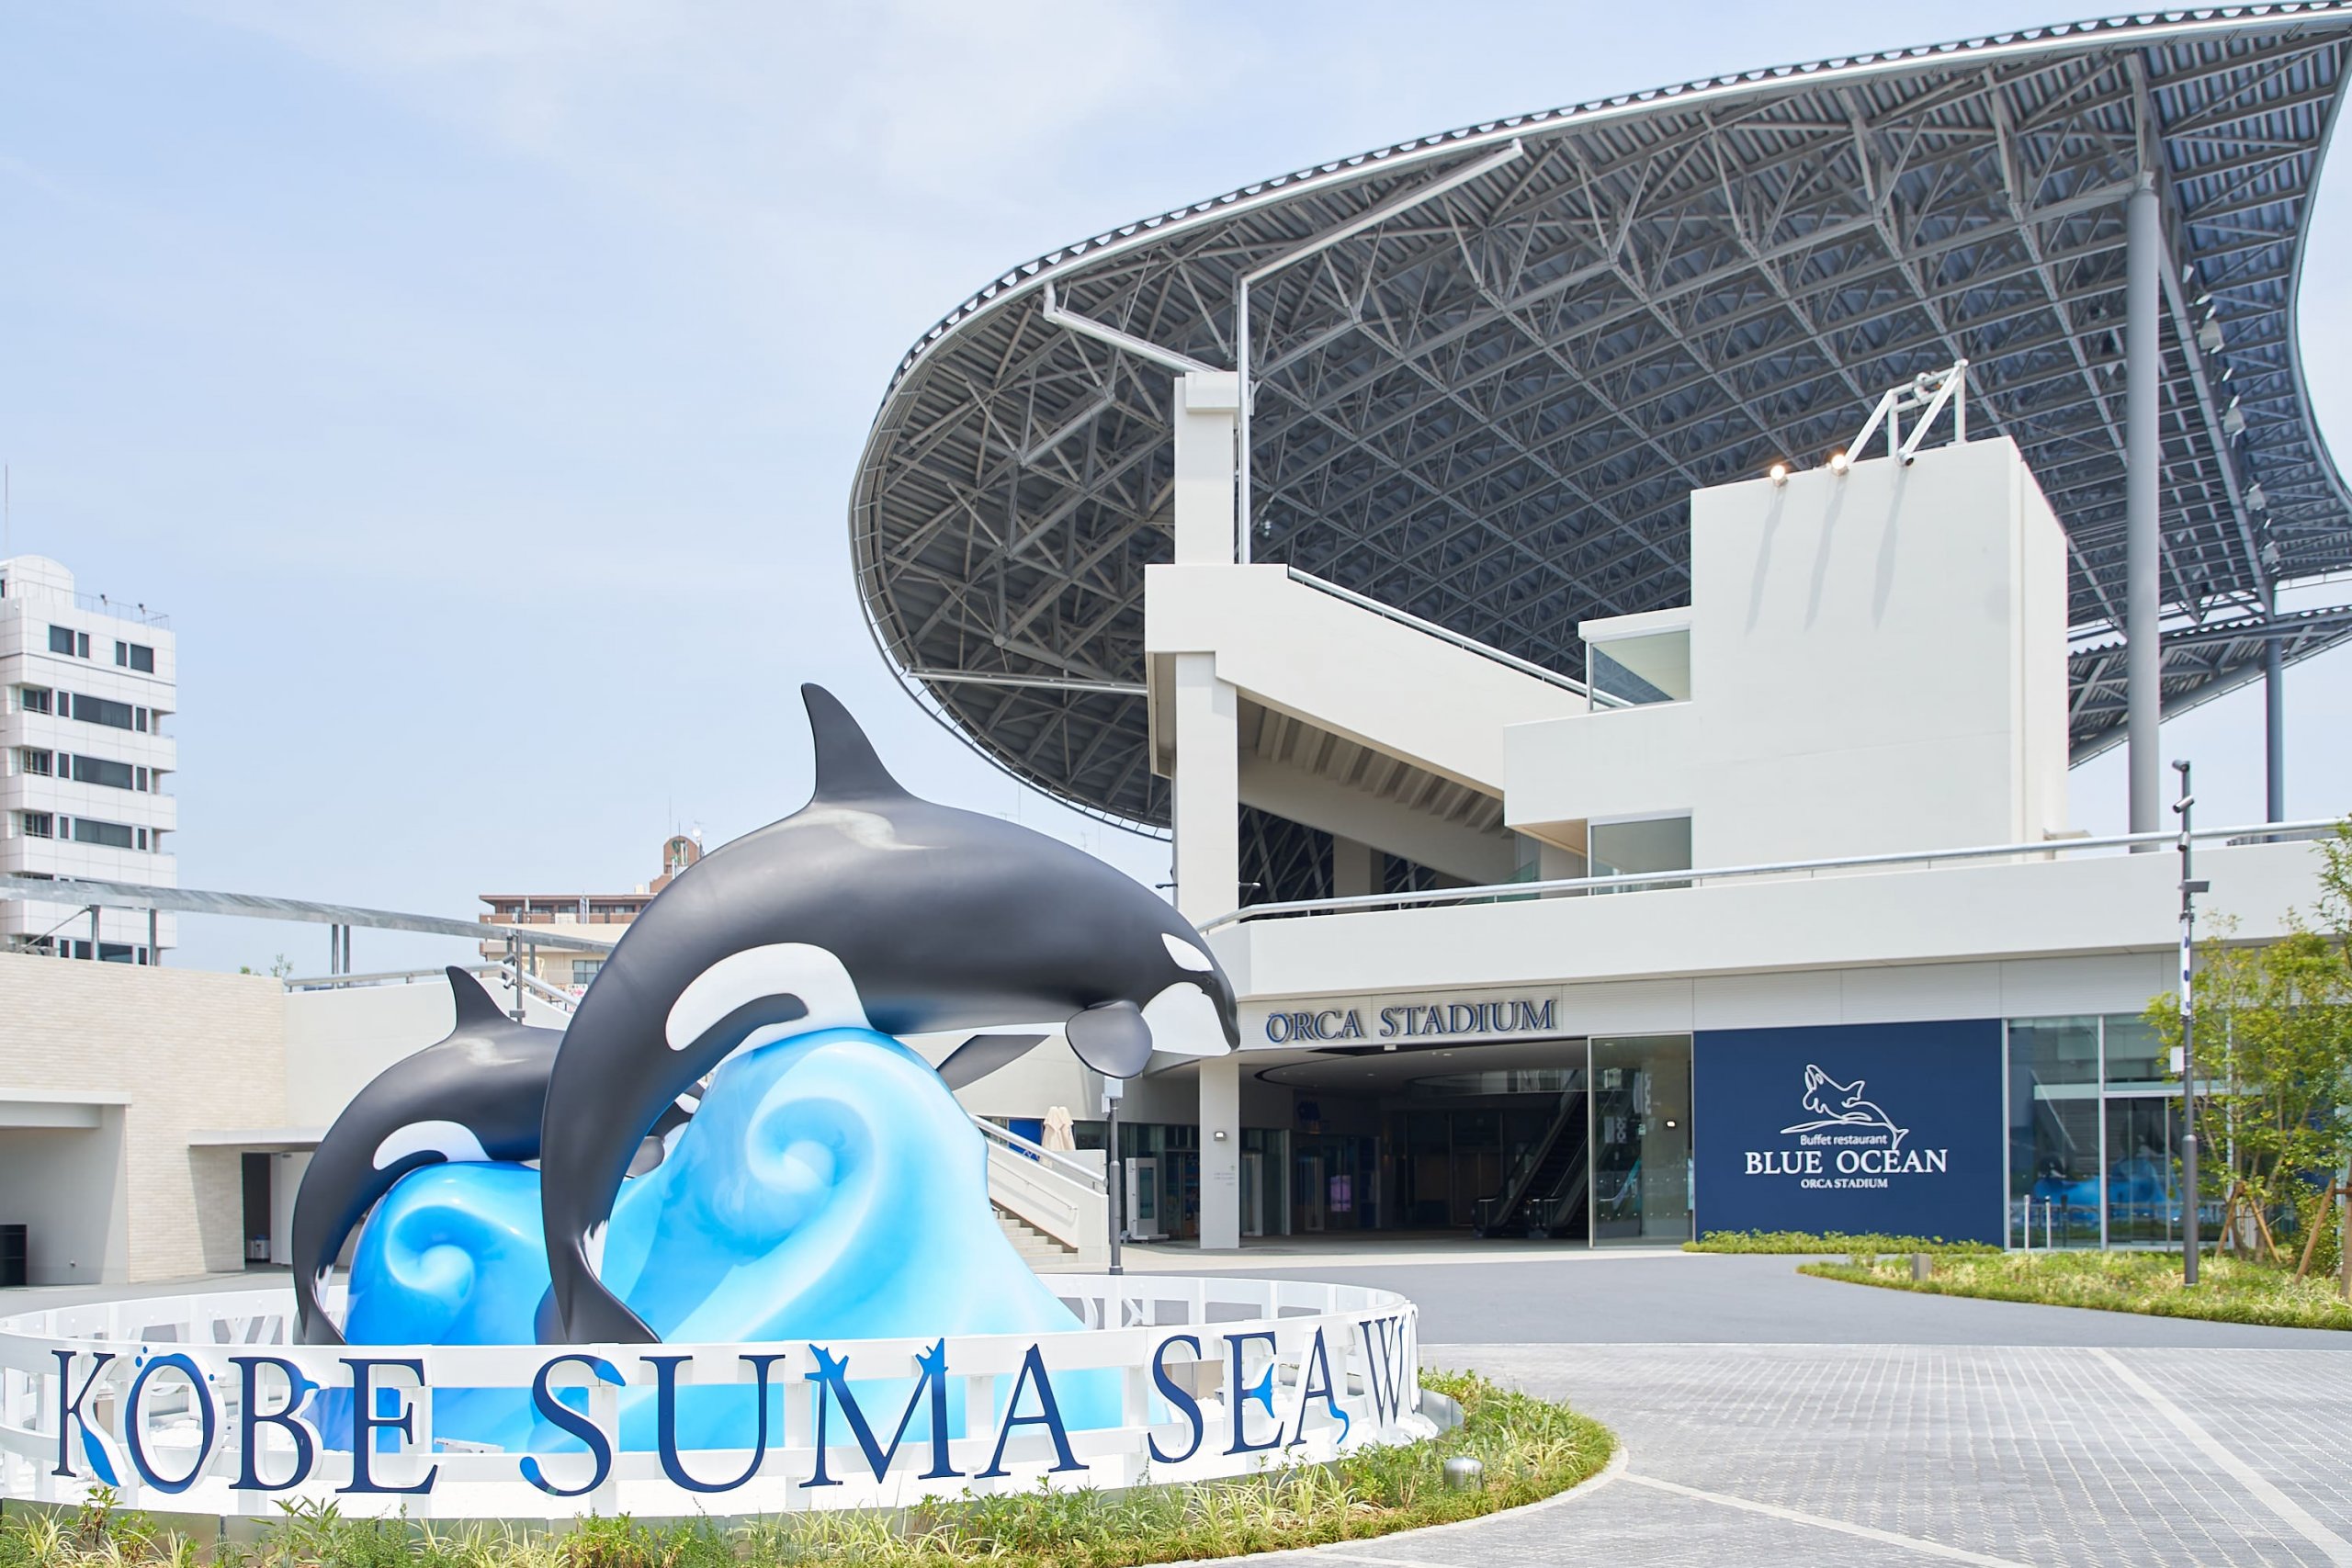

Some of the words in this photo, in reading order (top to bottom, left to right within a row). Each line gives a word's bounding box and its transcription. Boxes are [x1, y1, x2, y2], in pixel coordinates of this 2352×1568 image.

[1265, 1010, 1362, 1043] ORCA
[1379, 998, 1553, 1038] STADIUM
[1800, 1134, 1832, 1145] Buffet
[1833, 1134, 1888, 1145] restaurant
[1745, 1151, 1823, 1175] BLUE
[1836, 1149, 1948, 1174] OCEAN
[1800, 1179, 1833, 1189] ORCA
[1834, 1179, 1888, 1189] STADIUM
[51, 1346, 438, 1495] KOBE
[520, 1338, 1090, 1497] SUMA
